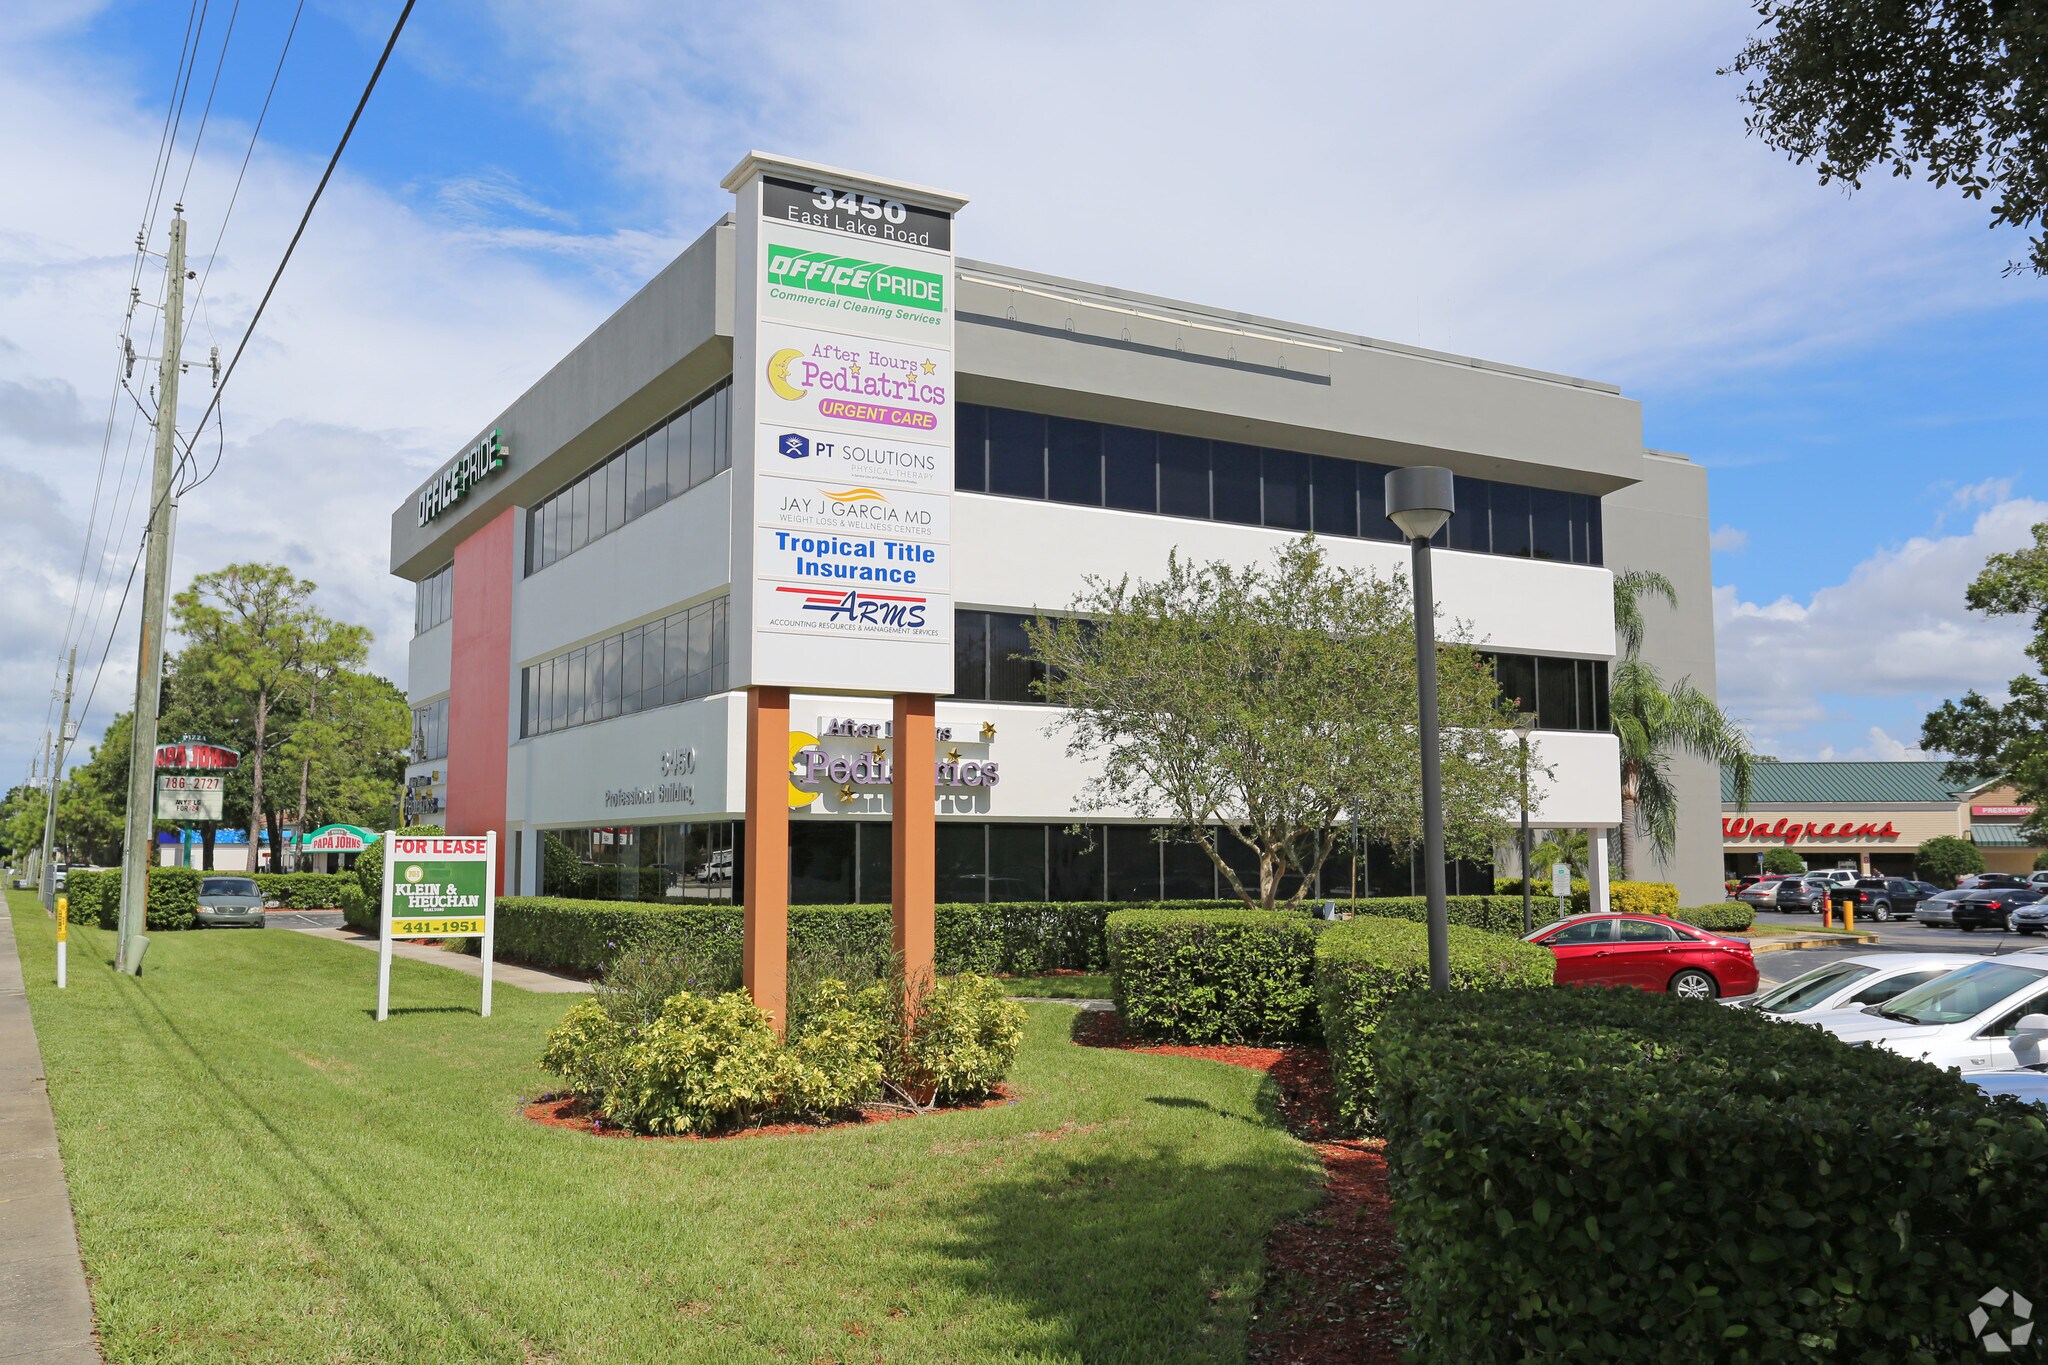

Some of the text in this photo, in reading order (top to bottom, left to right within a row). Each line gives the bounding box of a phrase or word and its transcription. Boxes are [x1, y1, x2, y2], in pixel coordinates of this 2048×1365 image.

[812, 186, 907, 224] 3450
[788, 206, 929, 246] East Lake Road
[769, 255, 941, 302] OFFICE PRIDE
[770, 288, 942, 326] Commercial Cleaning Services
[812, 343, 918, 372] After Hours
[801, 361, 945, 406] Pediatrics
[822, 400, 934, 428] URGENT CARE
[816, 442, 935, 470] PT SOLUTIONS
[418, 429, 502, 527] OFFICE PRIDE
[851, 464, 934, 480] PHYSICAL THERAPY
[780, 496, 932, 525] JAY J GARCIA MD
[779, 514, 932, 536] WEIGHT LOSS & WELLNESS CENTERS
[775, 531, 936, 564] Tropical Title
[796, 557, 917, 584] Insurance
[830, 590, 927, 628] ARMS
[769, 618, 817, 628] ACCOUNTING
[818, 621, 857, 632] RESOURCES
[863, 625, 911, 635] MANAGEMENT
[912, 628, 939, 637] SERVICES
[824, 718, 881, 738] After
[155, 745, 187, 768] APA
[661, 746, 696, 777] 3450
[801, 750, 1000, 787] Pedirics
[605, 783, 695, 808] Professional Building
[313, 835, 361, 849] PAPA JOHNS
[1722, 817, 1901, 844] Walgreens
[394, 839, 486, 854] FOR LEASE
[395, 883, 457, 896] KLEIN &
[408, 895, 480, 908] HEUCHAN
[403, 921, 477, 933] 441-1951
